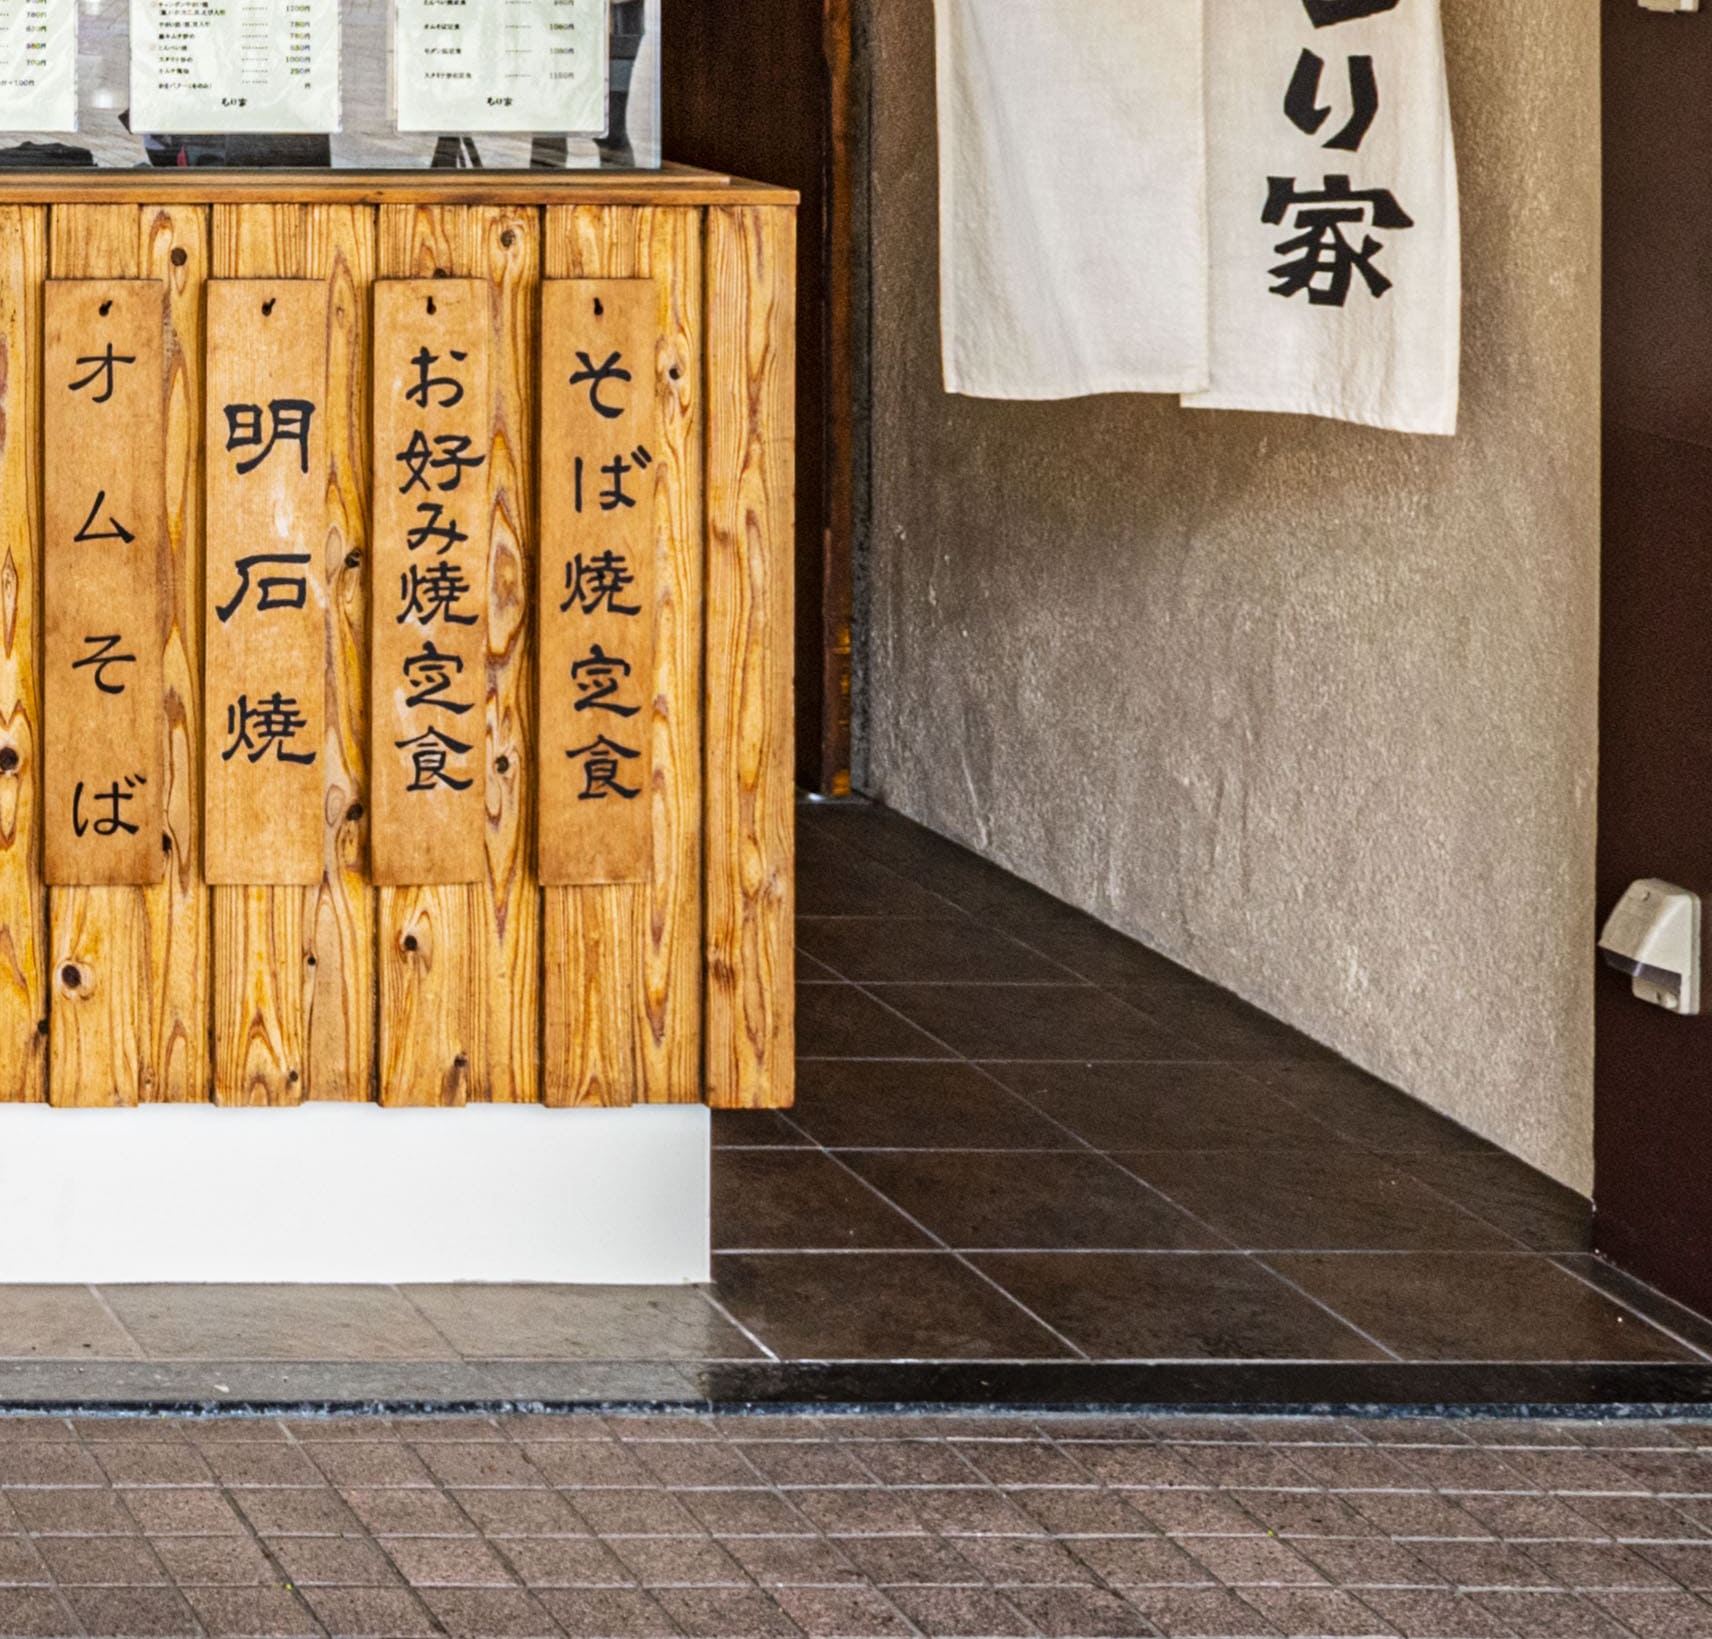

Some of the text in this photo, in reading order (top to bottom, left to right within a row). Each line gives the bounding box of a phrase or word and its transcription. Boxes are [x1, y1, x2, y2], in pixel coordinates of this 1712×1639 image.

[220, 97, 248, 108] もり家
[486, 96, 514, 107] もり家
[68, 343, 147, 837] オムそば
[215, 398, 317, 766] 明石焼
[394, 346, 485, 792] お好み焼定食
[558, 349, 653, 800] そば焼定食
